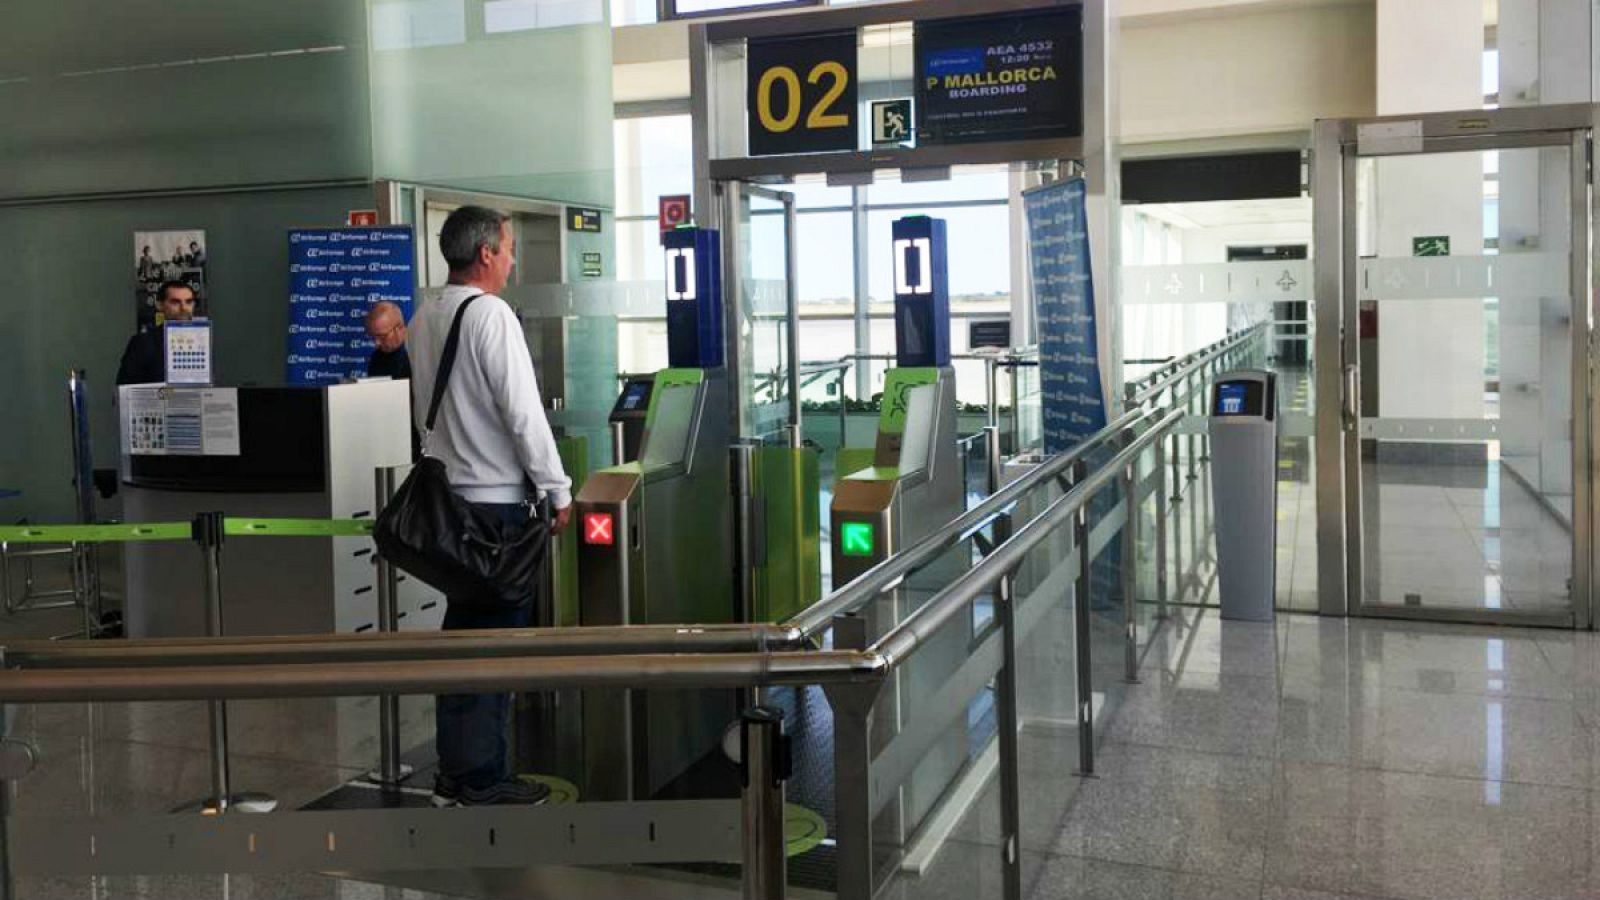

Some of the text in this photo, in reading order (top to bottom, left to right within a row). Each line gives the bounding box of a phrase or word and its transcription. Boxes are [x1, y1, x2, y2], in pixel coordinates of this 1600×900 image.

[986, 40, 1054, 56] AEA 4532
[927, 66, 1057, 90] P MALLORCA
[757, 60, 850, 133] 02
[949, 84, 1028, 98] BOARDING
